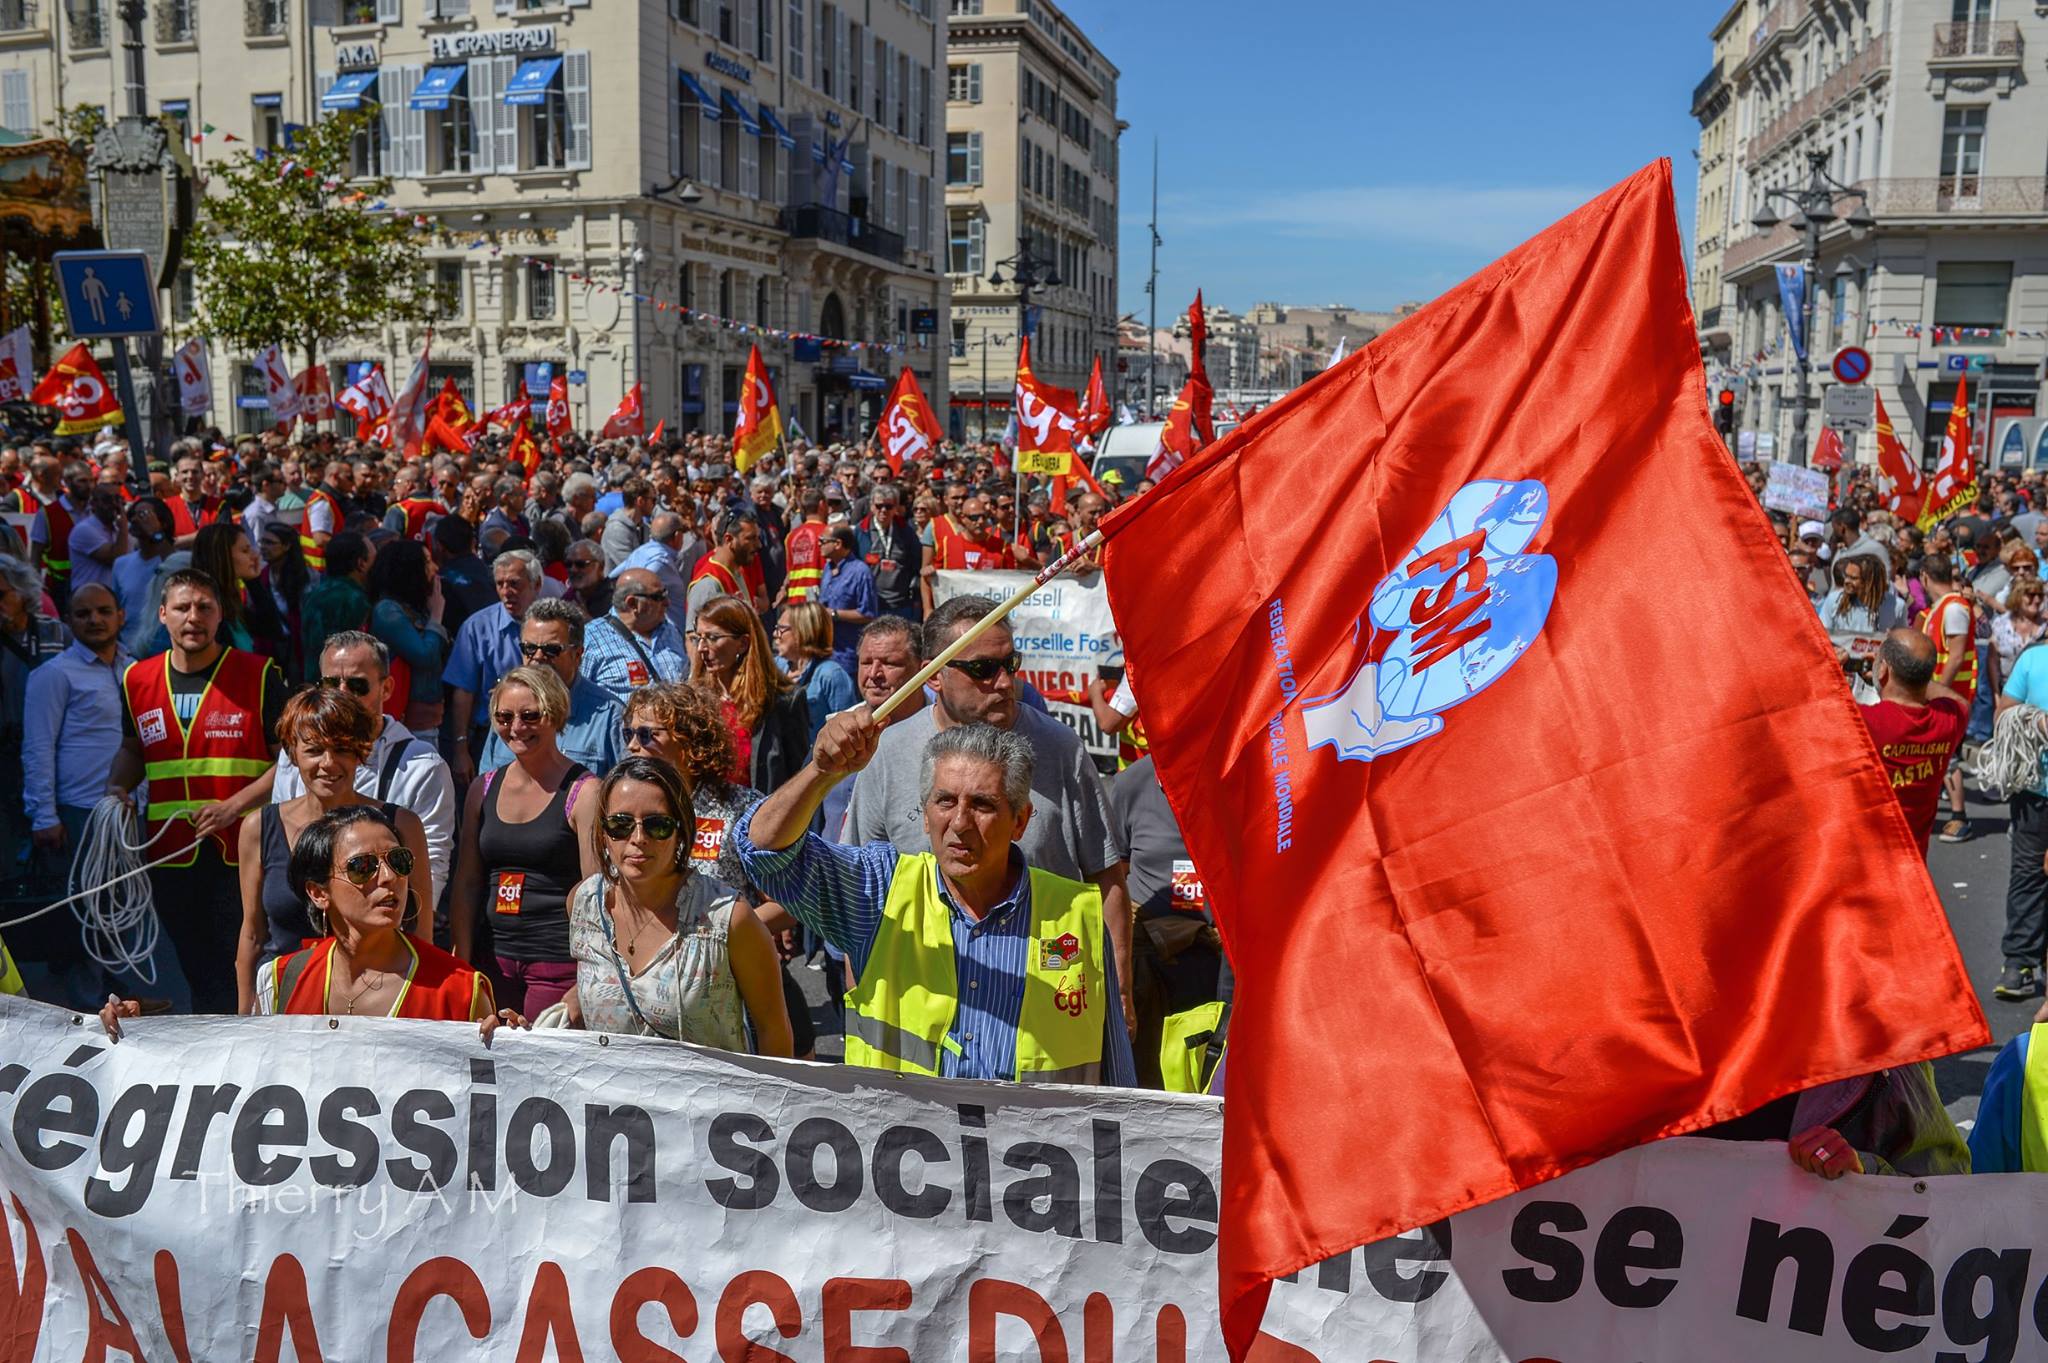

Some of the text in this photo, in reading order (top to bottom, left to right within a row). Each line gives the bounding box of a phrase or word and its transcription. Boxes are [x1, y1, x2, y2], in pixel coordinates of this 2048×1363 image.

[1407, 528, 1493, 677] FSM
[1014, 632, 1110, 652] arseille Fos
[204, 730, 243, 739] VITROLLES
[1882, 741, 1950, 758] CAPITALISME
[1891, 759, 1935, 788] ASTA
[1274, 770, 1292, 854] MONDIALE
[695, 830, 722, 849] cgt
[499, 883, 521, 902] cgt
[1174, 880, 1204, 901] cgt
[1054, 984, 1088, 1018] cgt
[705, 1104, 1219, 1255] sociale
[1502, 1200, 1684, 1309] se
[1735, 1214, 2048, 1363] nég
